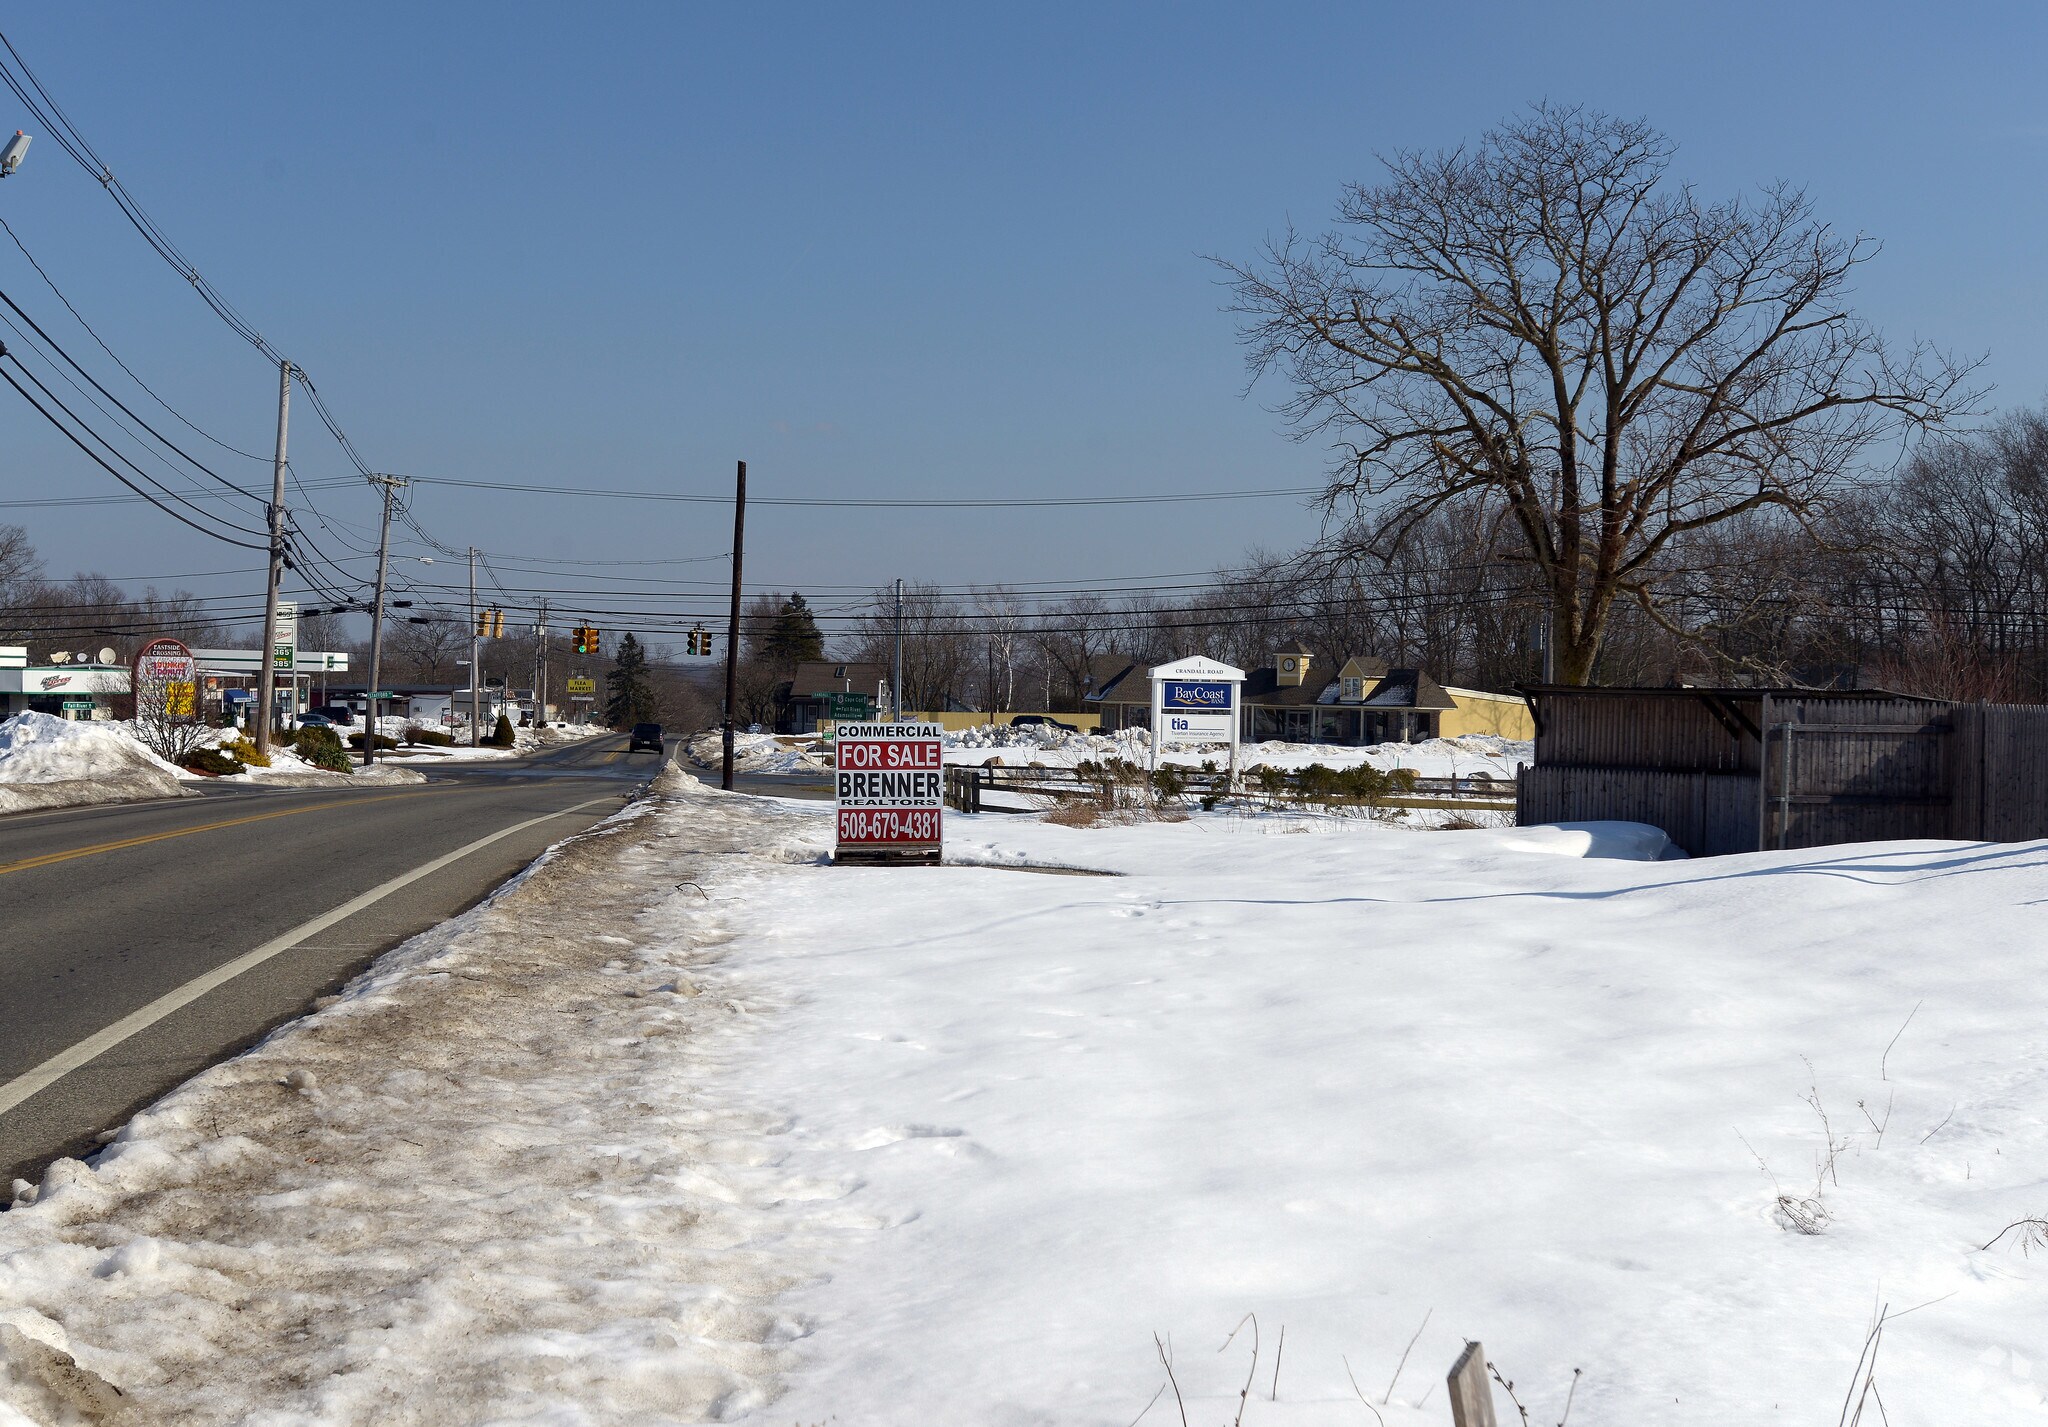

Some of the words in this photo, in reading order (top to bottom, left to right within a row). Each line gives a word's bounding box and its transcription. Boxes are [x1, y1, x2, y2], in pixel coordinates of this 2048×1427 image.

[1174, 686, 1225, 702] BayCoast
[838, 726, 941, 737] COMMERCIAL
[1171, 718, 1189, 730] tia
[842, 745, 882, 767] FOR
[887, 745, 938, 767] SALE
[838, 772, 940, 798] BRENNER
[840, 812, 939, 839] 508-679-4381
